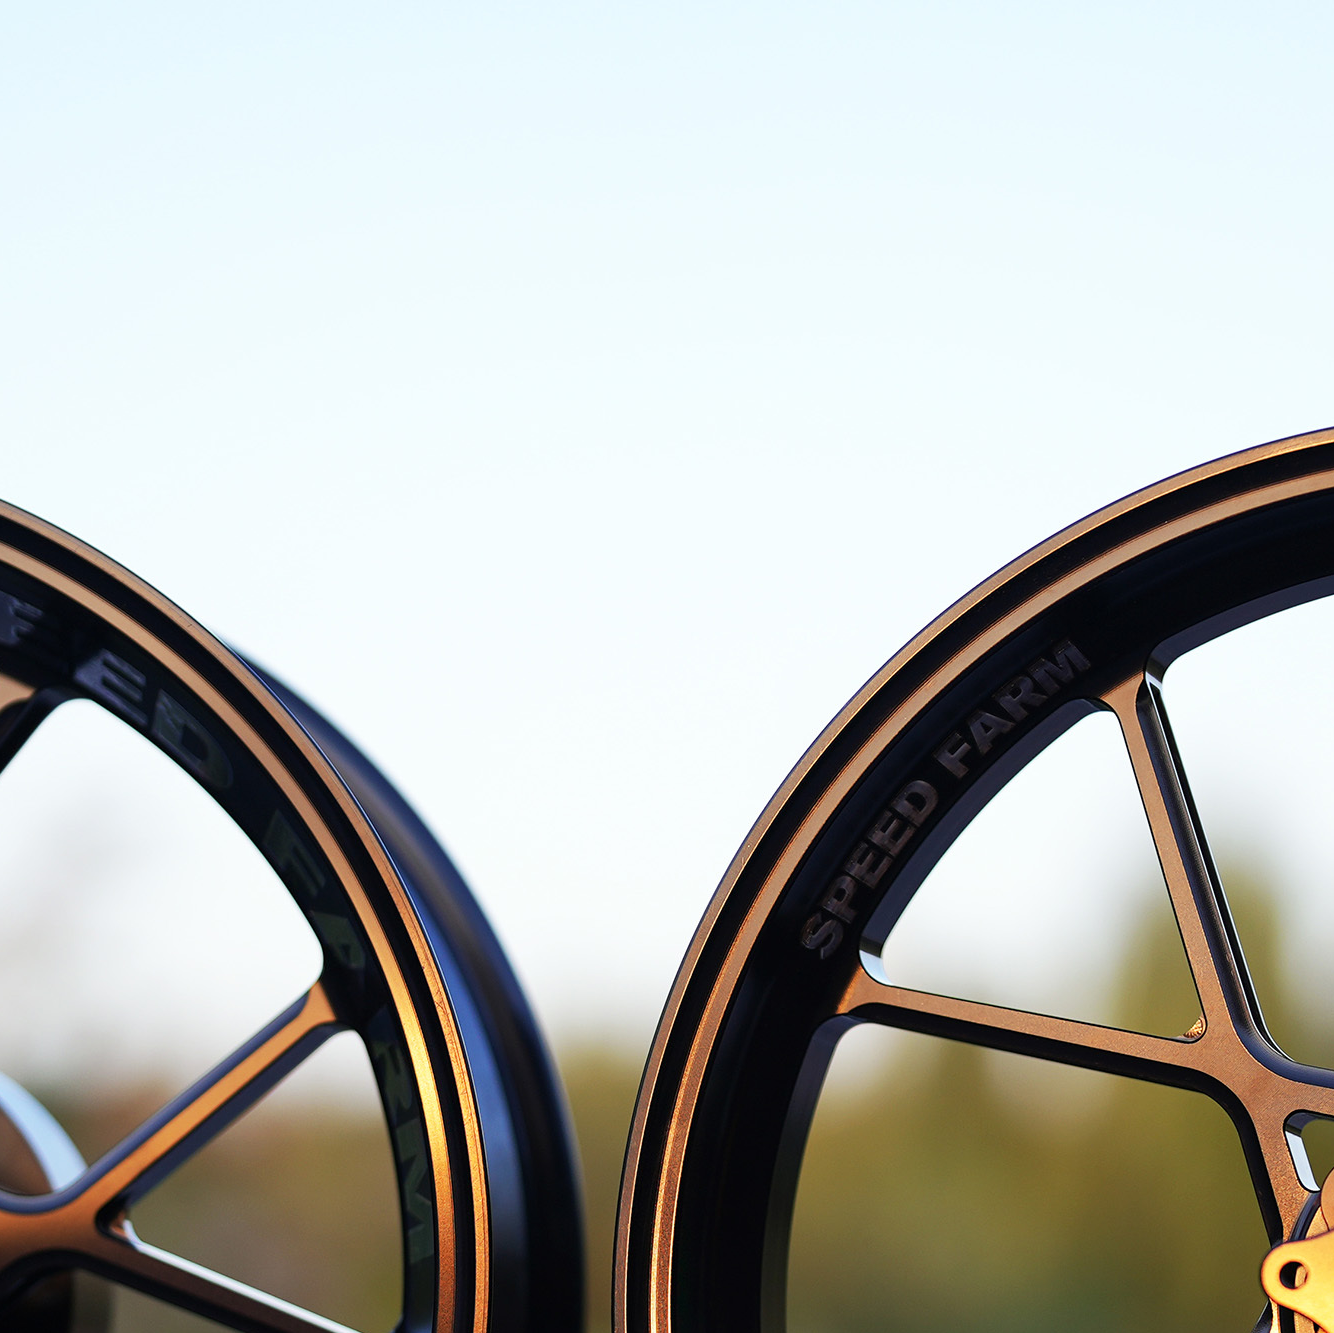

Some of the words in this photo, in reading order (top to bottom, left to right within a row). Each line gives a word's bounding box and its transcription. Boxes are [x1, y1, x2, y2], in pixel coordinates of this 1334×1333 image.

[800, 777, 940, 961] SPEED
[932, 637, 1092, 782] FARM
[268, 810, 435, 1265] FARM
